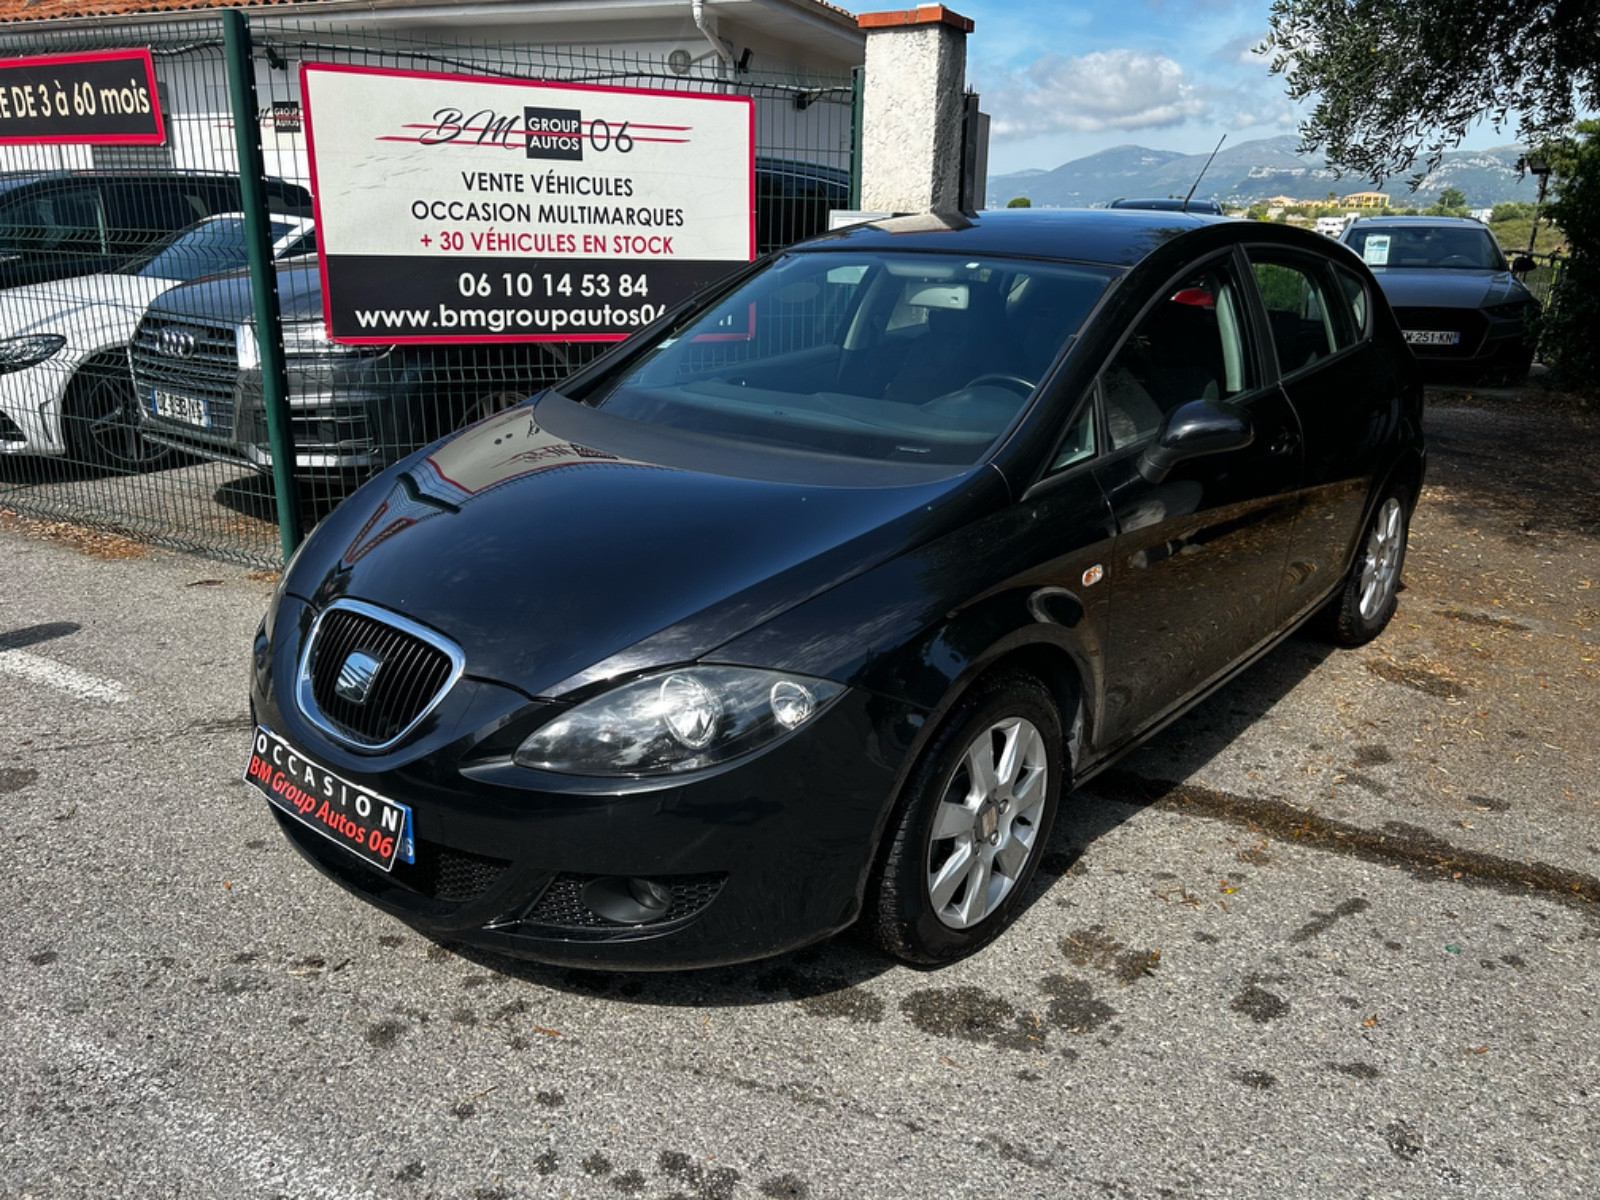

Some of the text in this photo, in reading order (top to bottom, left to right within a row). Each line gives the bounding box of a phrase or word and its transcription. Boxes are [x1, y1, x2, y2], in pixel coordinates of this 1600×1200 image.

[0, 78, 150, 118] E DE 3 à 60 mois
[419, 107, 521, 150] BM
[528, 117, 579, 133] GROUP
[590, 118, 634, 153] 06
[529, 134, 580, 151] AUTOS
[461, 169, 634, 197] VENTE VÉHICULES
[411, 199, 684, 227] OCCASION MULTIMARQUES
[420, 226, 674, 255] + 30 VÉHICULES EN STOCK
[458, 272, 650, 297] 06 10 14 53 84
[1402, 331, 1453, 343] W-251-KN
[256, 734, 398, 832] OCCASION
[249, 754, 394, 858] BM Group Autos 06
